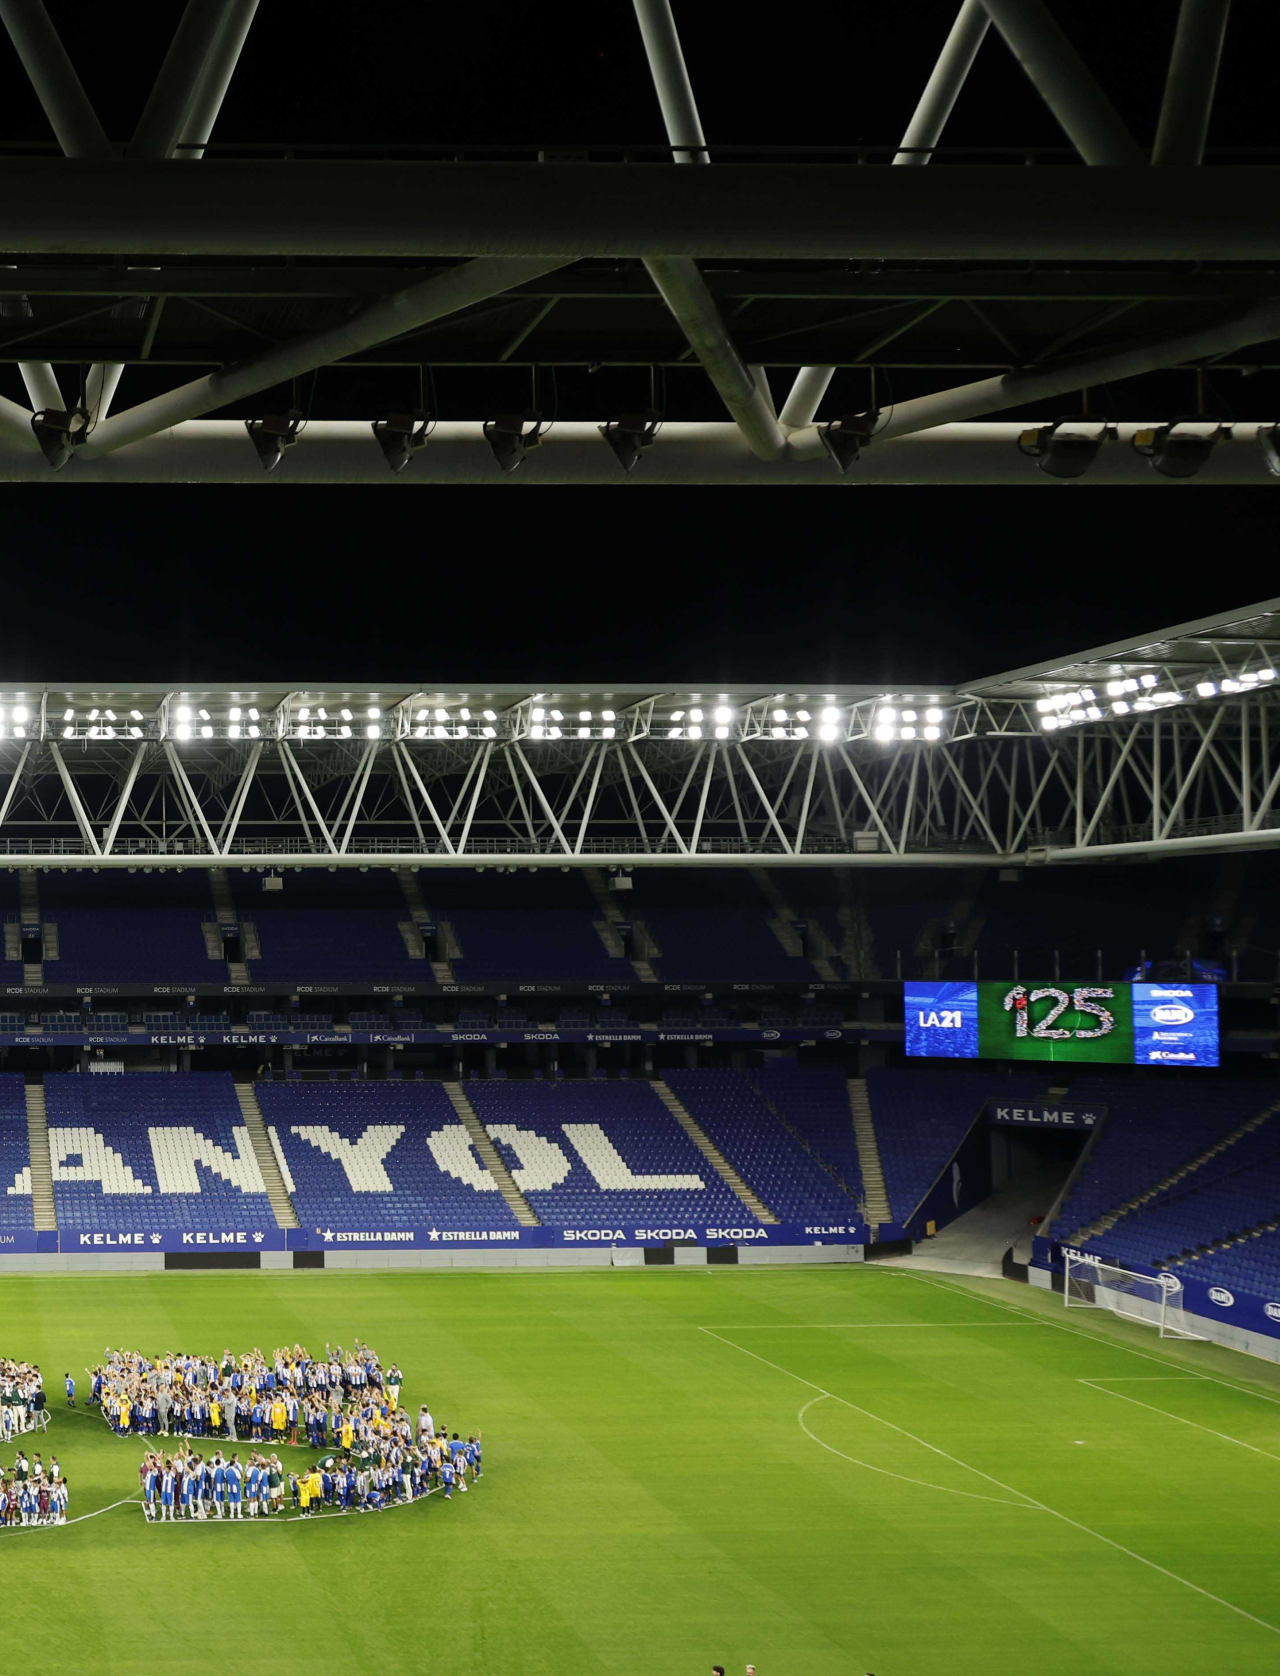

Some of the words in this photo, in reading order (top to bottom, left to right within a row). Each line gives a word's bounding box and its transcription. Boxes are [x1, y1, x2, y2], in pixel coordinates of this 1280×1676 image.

[919, 1010, 962, 1028] LA21
[294, 1049, 332, 1057] ELME
[996, 1108, 1075, 1124] KELME
[80, 1233, 144, 1244] KELME
[183, 1232, 247, 1244] KELME
[337, 1232, 382, 1241] ESTRELLA
[384, 1232, 414, 1241] DAMM
[443, 1231, 488, 1240] ESTRELLA
[489, 1231, 519, 1240] DAMM
[563, 1230, 626, 1241] SKODA
[635, 1229, 697, 1240] SKODA
[706, 1228, 768, 1239] SKODA
